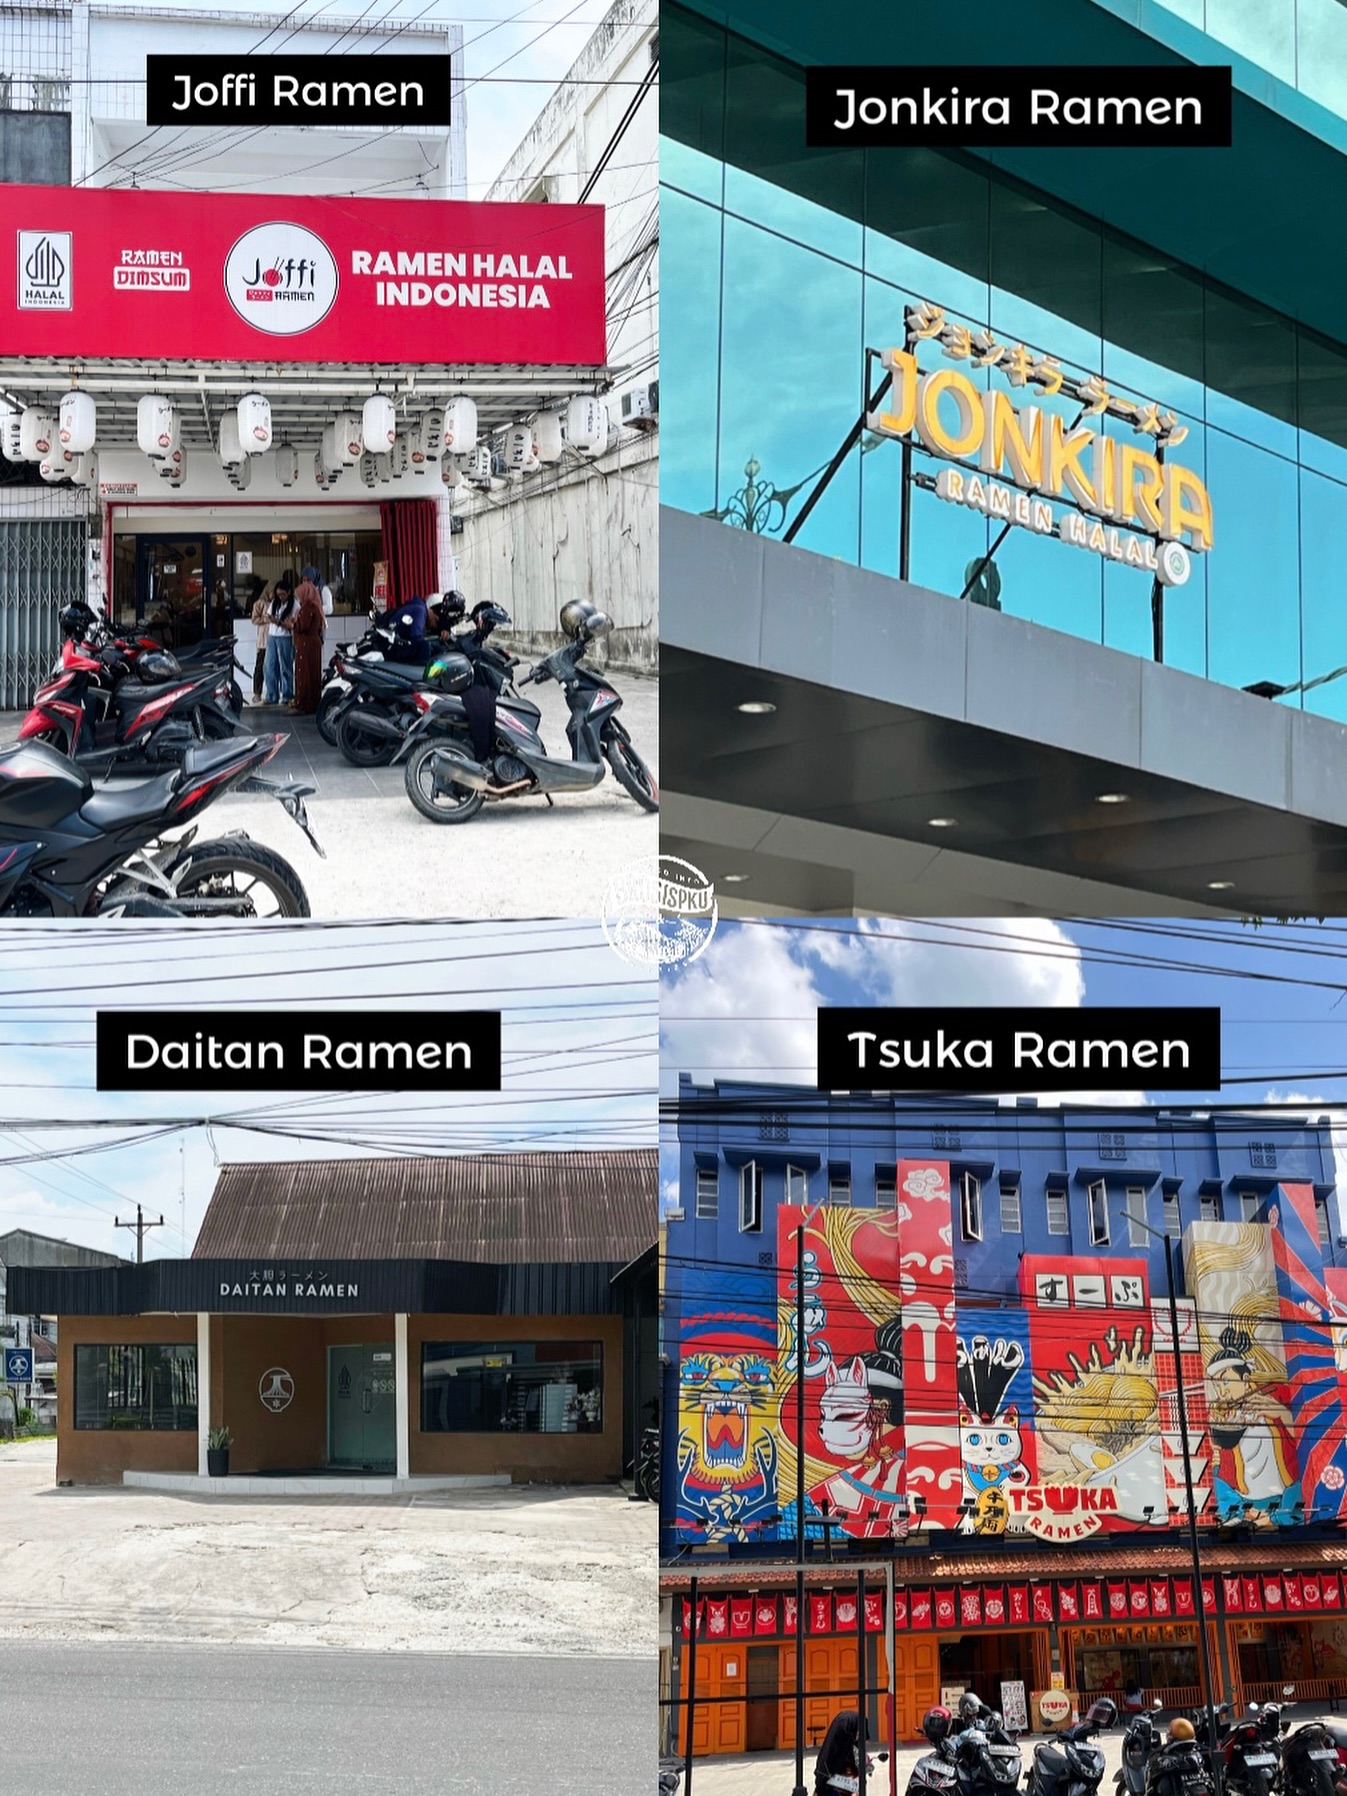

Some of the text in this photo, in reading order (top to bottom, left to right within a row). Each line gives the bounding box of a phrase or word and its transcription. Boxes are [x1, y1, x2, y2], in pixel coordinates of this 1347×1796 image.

[121, 250, 183, 266] RAMEN
[352, 250, 573, 279] RAMEN HALAL
[117, 270, 188, 287] DIMSUM
[242, 257, 317, 289] Joffi
[25, 290, 65, 300] HALAL
[274, 291, 315, 301] RAMEN
[376, 281, 551, 309] INDONESIA
[866, 346, 1214, 552] JONKIRA
[938, 468, 1158, 570] RAMEN HALAL
[220, 1283, 359, 1297] DAITAN RAMEN
[1038, 1277, 1140, 1303] すーぷ
[1009, 1483, 1118, 1516] TSUKA
[1029, 1515, 1097, 1539] RAMEN
